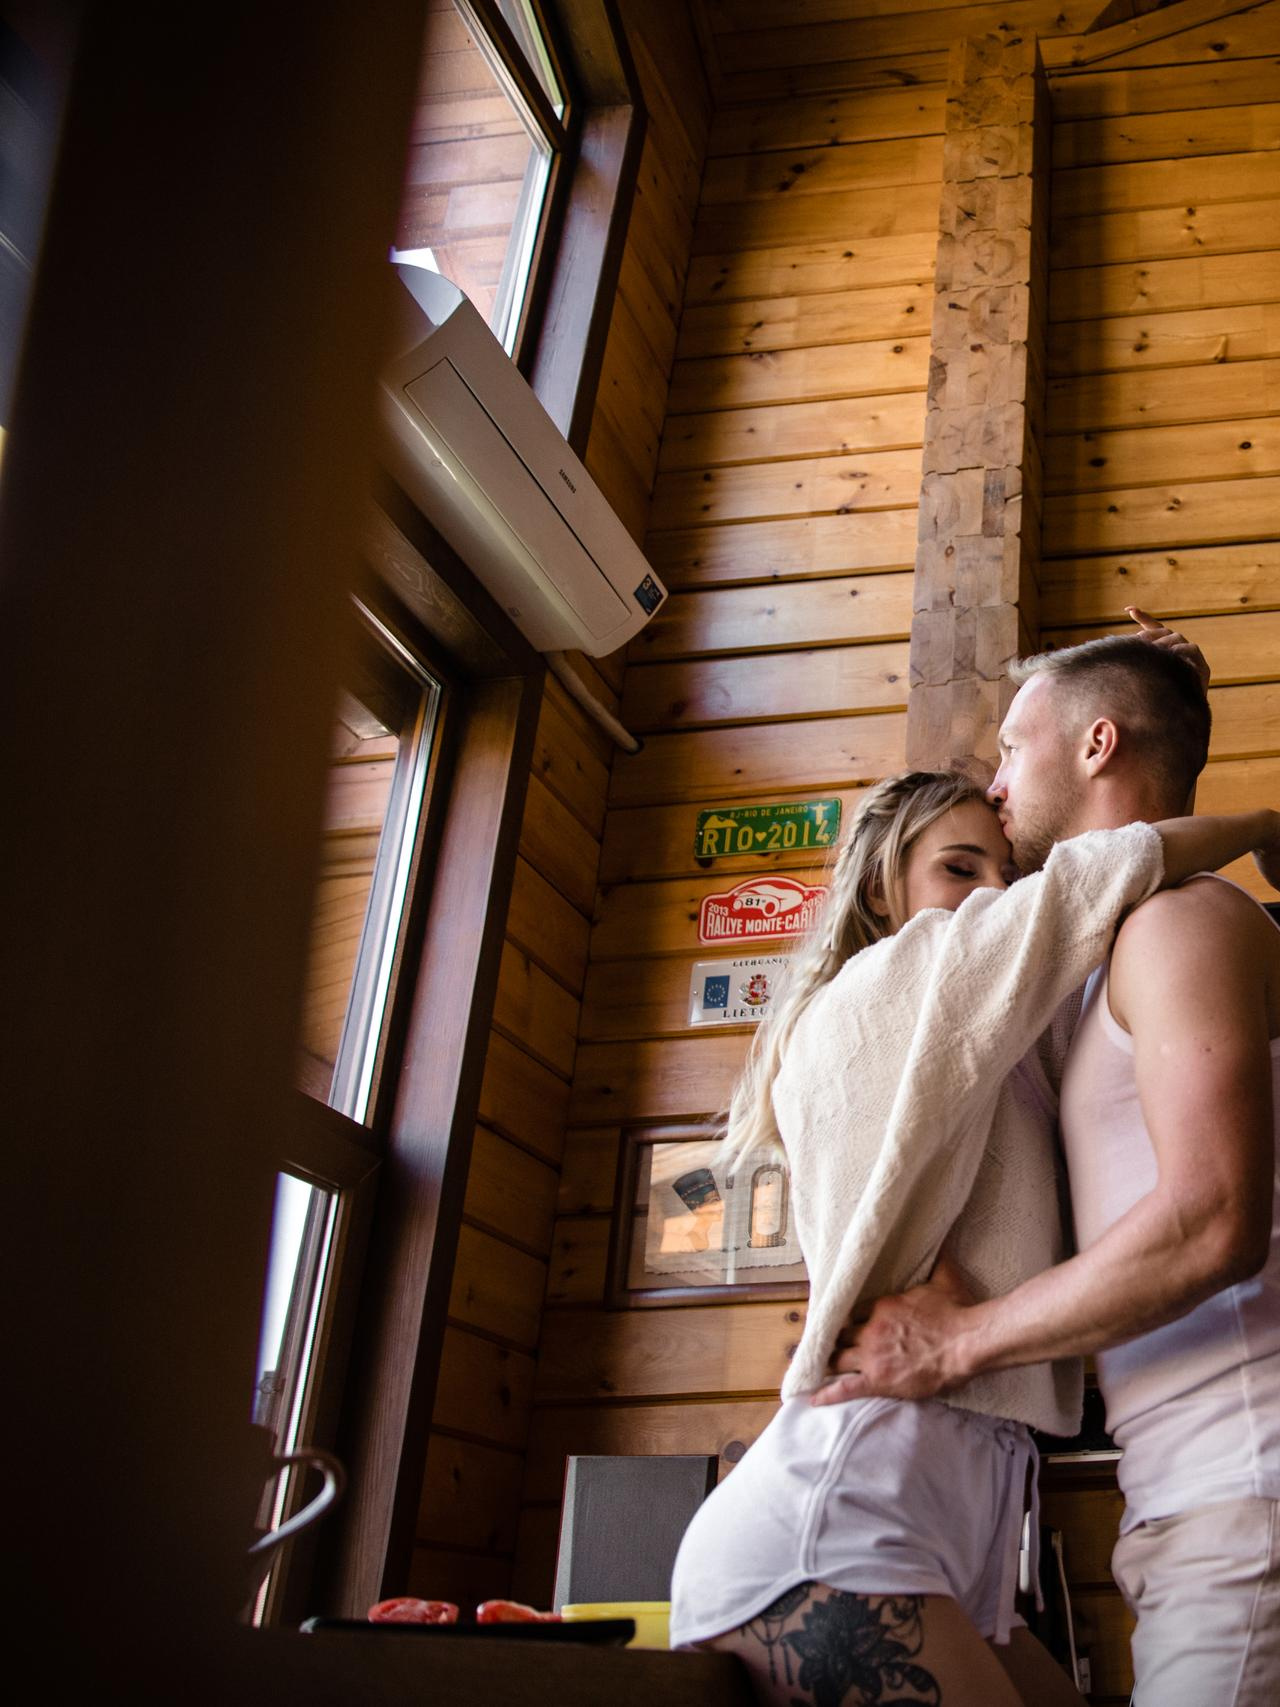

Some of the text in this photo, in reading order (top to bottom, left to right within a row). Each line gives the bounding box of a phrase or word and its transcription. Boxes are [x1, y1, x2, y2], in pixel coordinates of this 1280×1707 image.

[558, 468, 578, 494] SAMSUNG
[761, 808, 772, 817] DE
[775, 805, 808, 816] JANEIRO
[702, 819, 830, 854] RIO 2014
[708, 902, 729, 917] 2013
[706, 911, 743, 937] RALLYE
[732, 957, 789, 967] LITHUANI
[723, 1007, 770, 1018] LIETU
